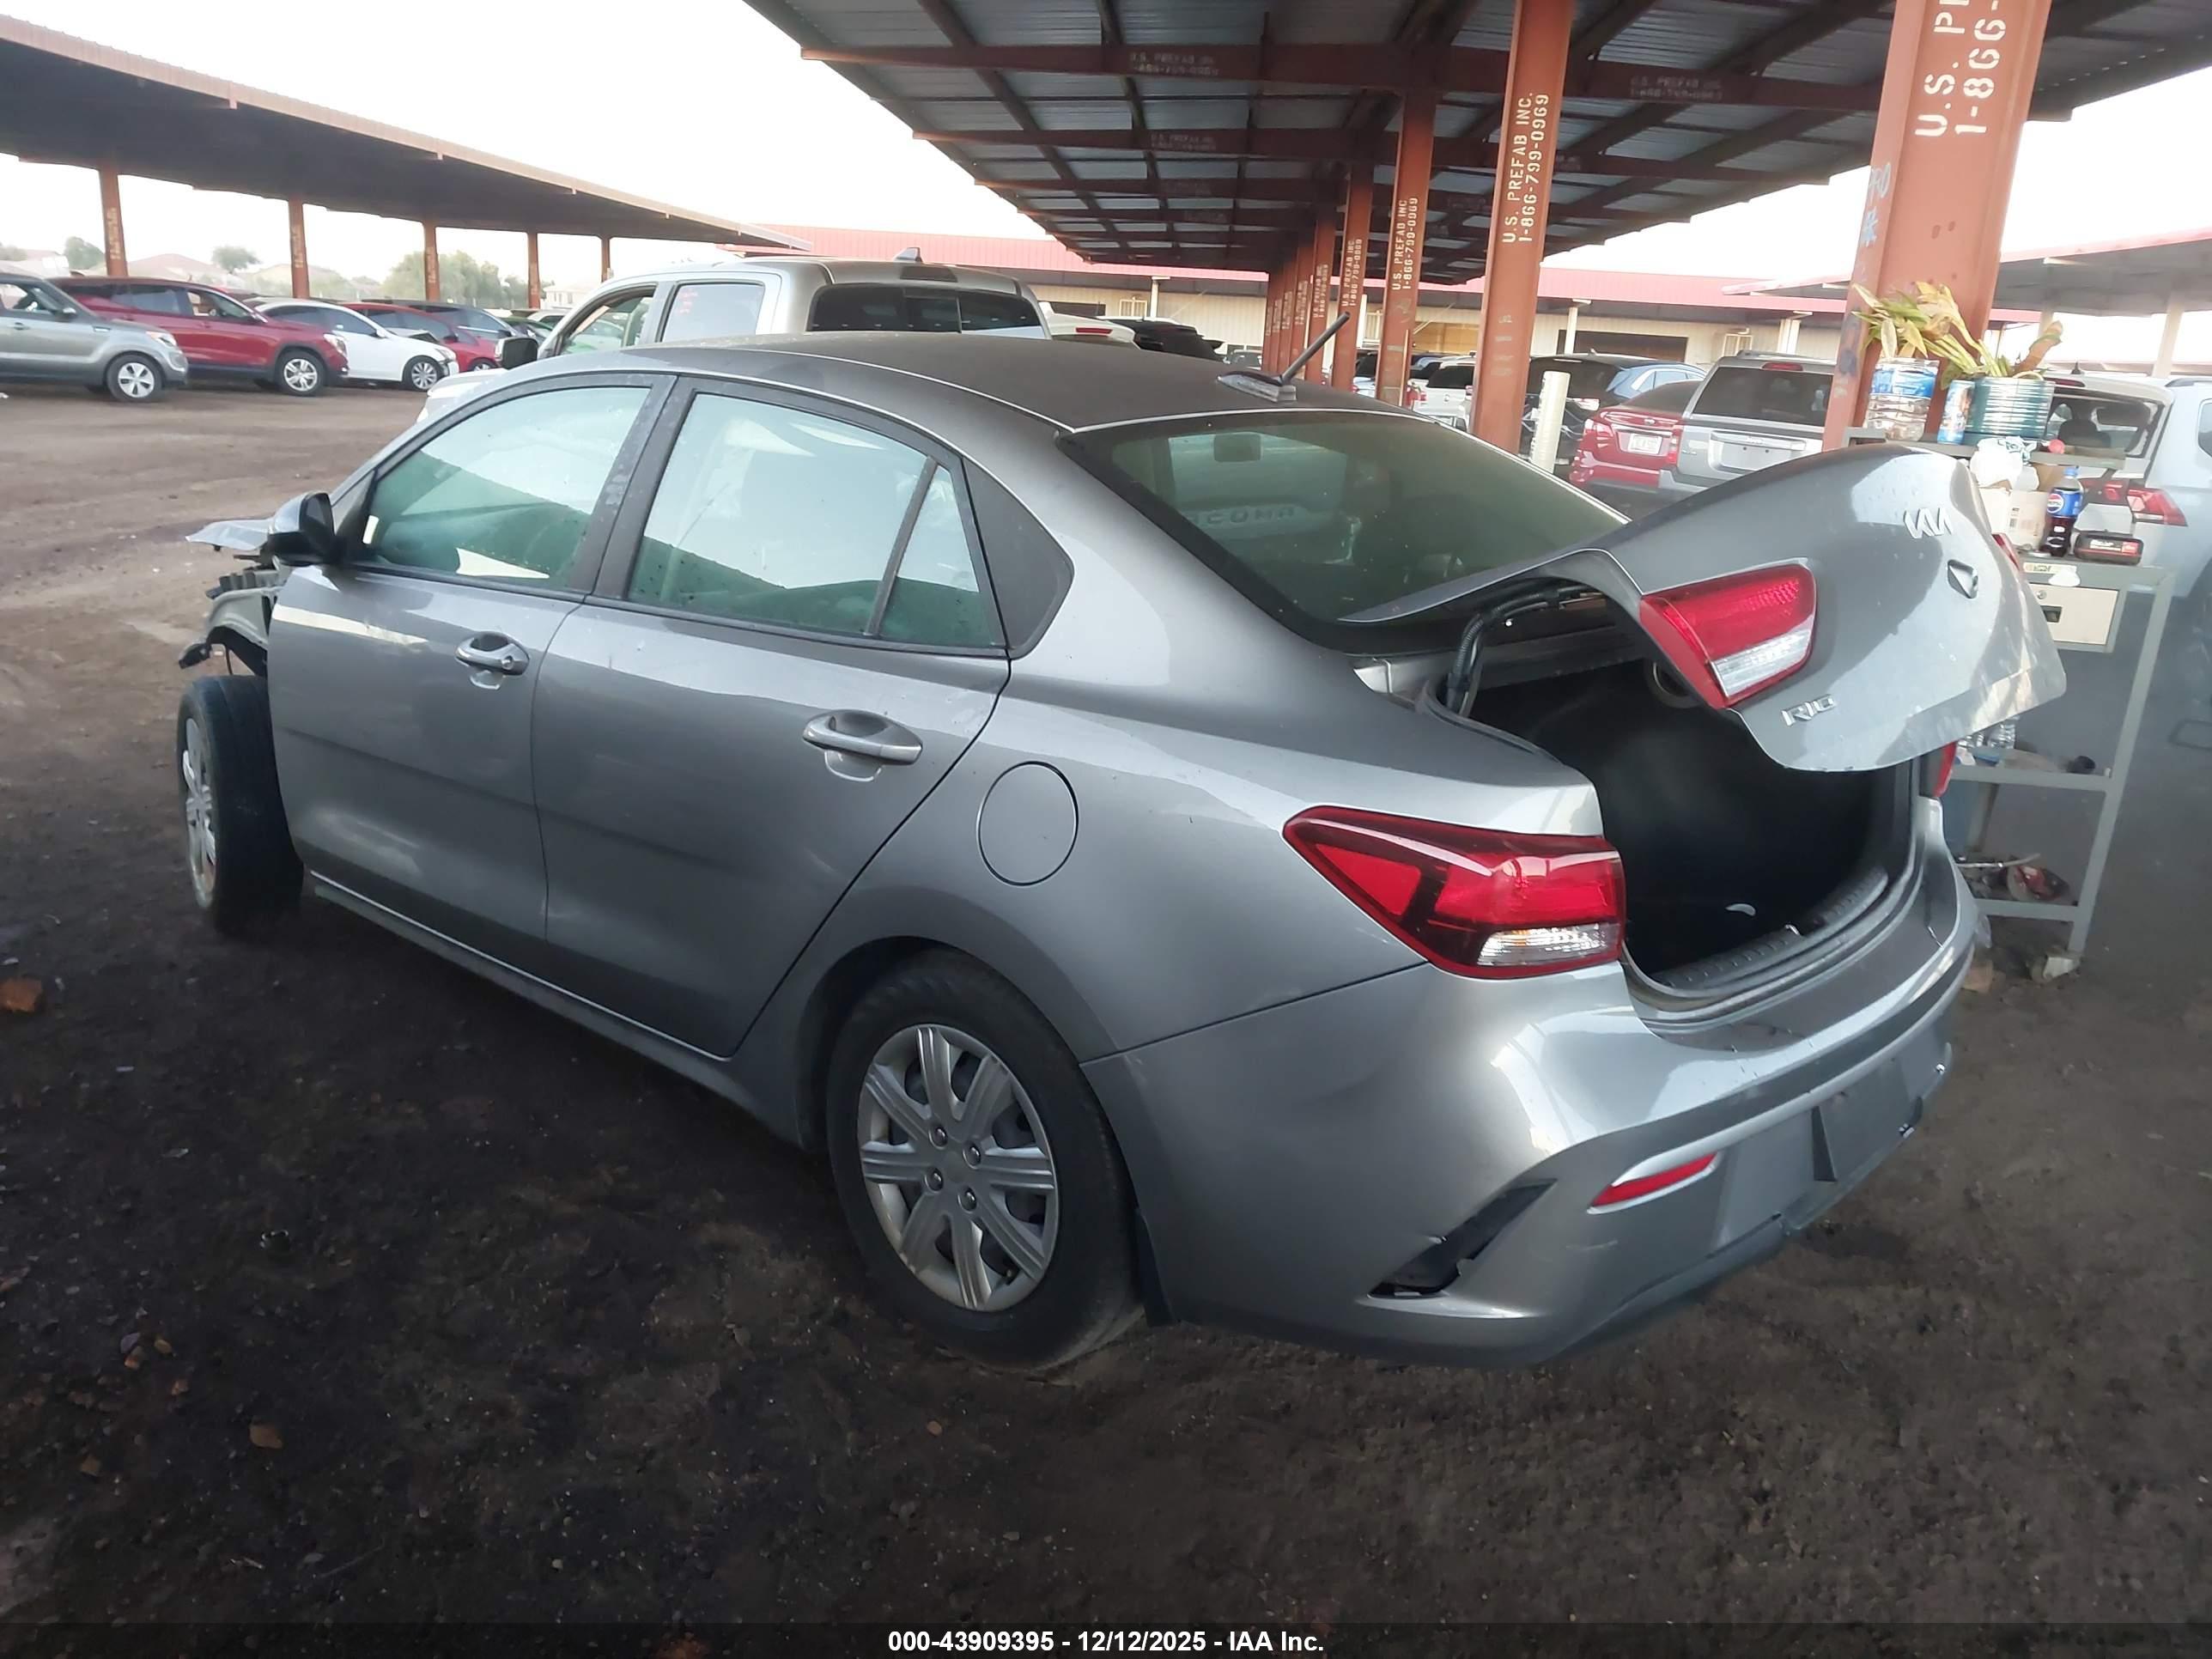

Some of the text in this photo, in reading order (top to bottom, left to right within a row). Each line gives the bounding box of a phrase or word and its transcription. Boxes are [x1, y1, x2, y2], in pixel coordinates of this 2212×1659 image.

[1914, 0, 1971, 137] U.S. P
[1502, 92, 1534, 243] U.S. PREFAB INC.
[1518, 94, 1549, 242] 1-866-799-0969
[1780, 695, 1835, 727] RIO
